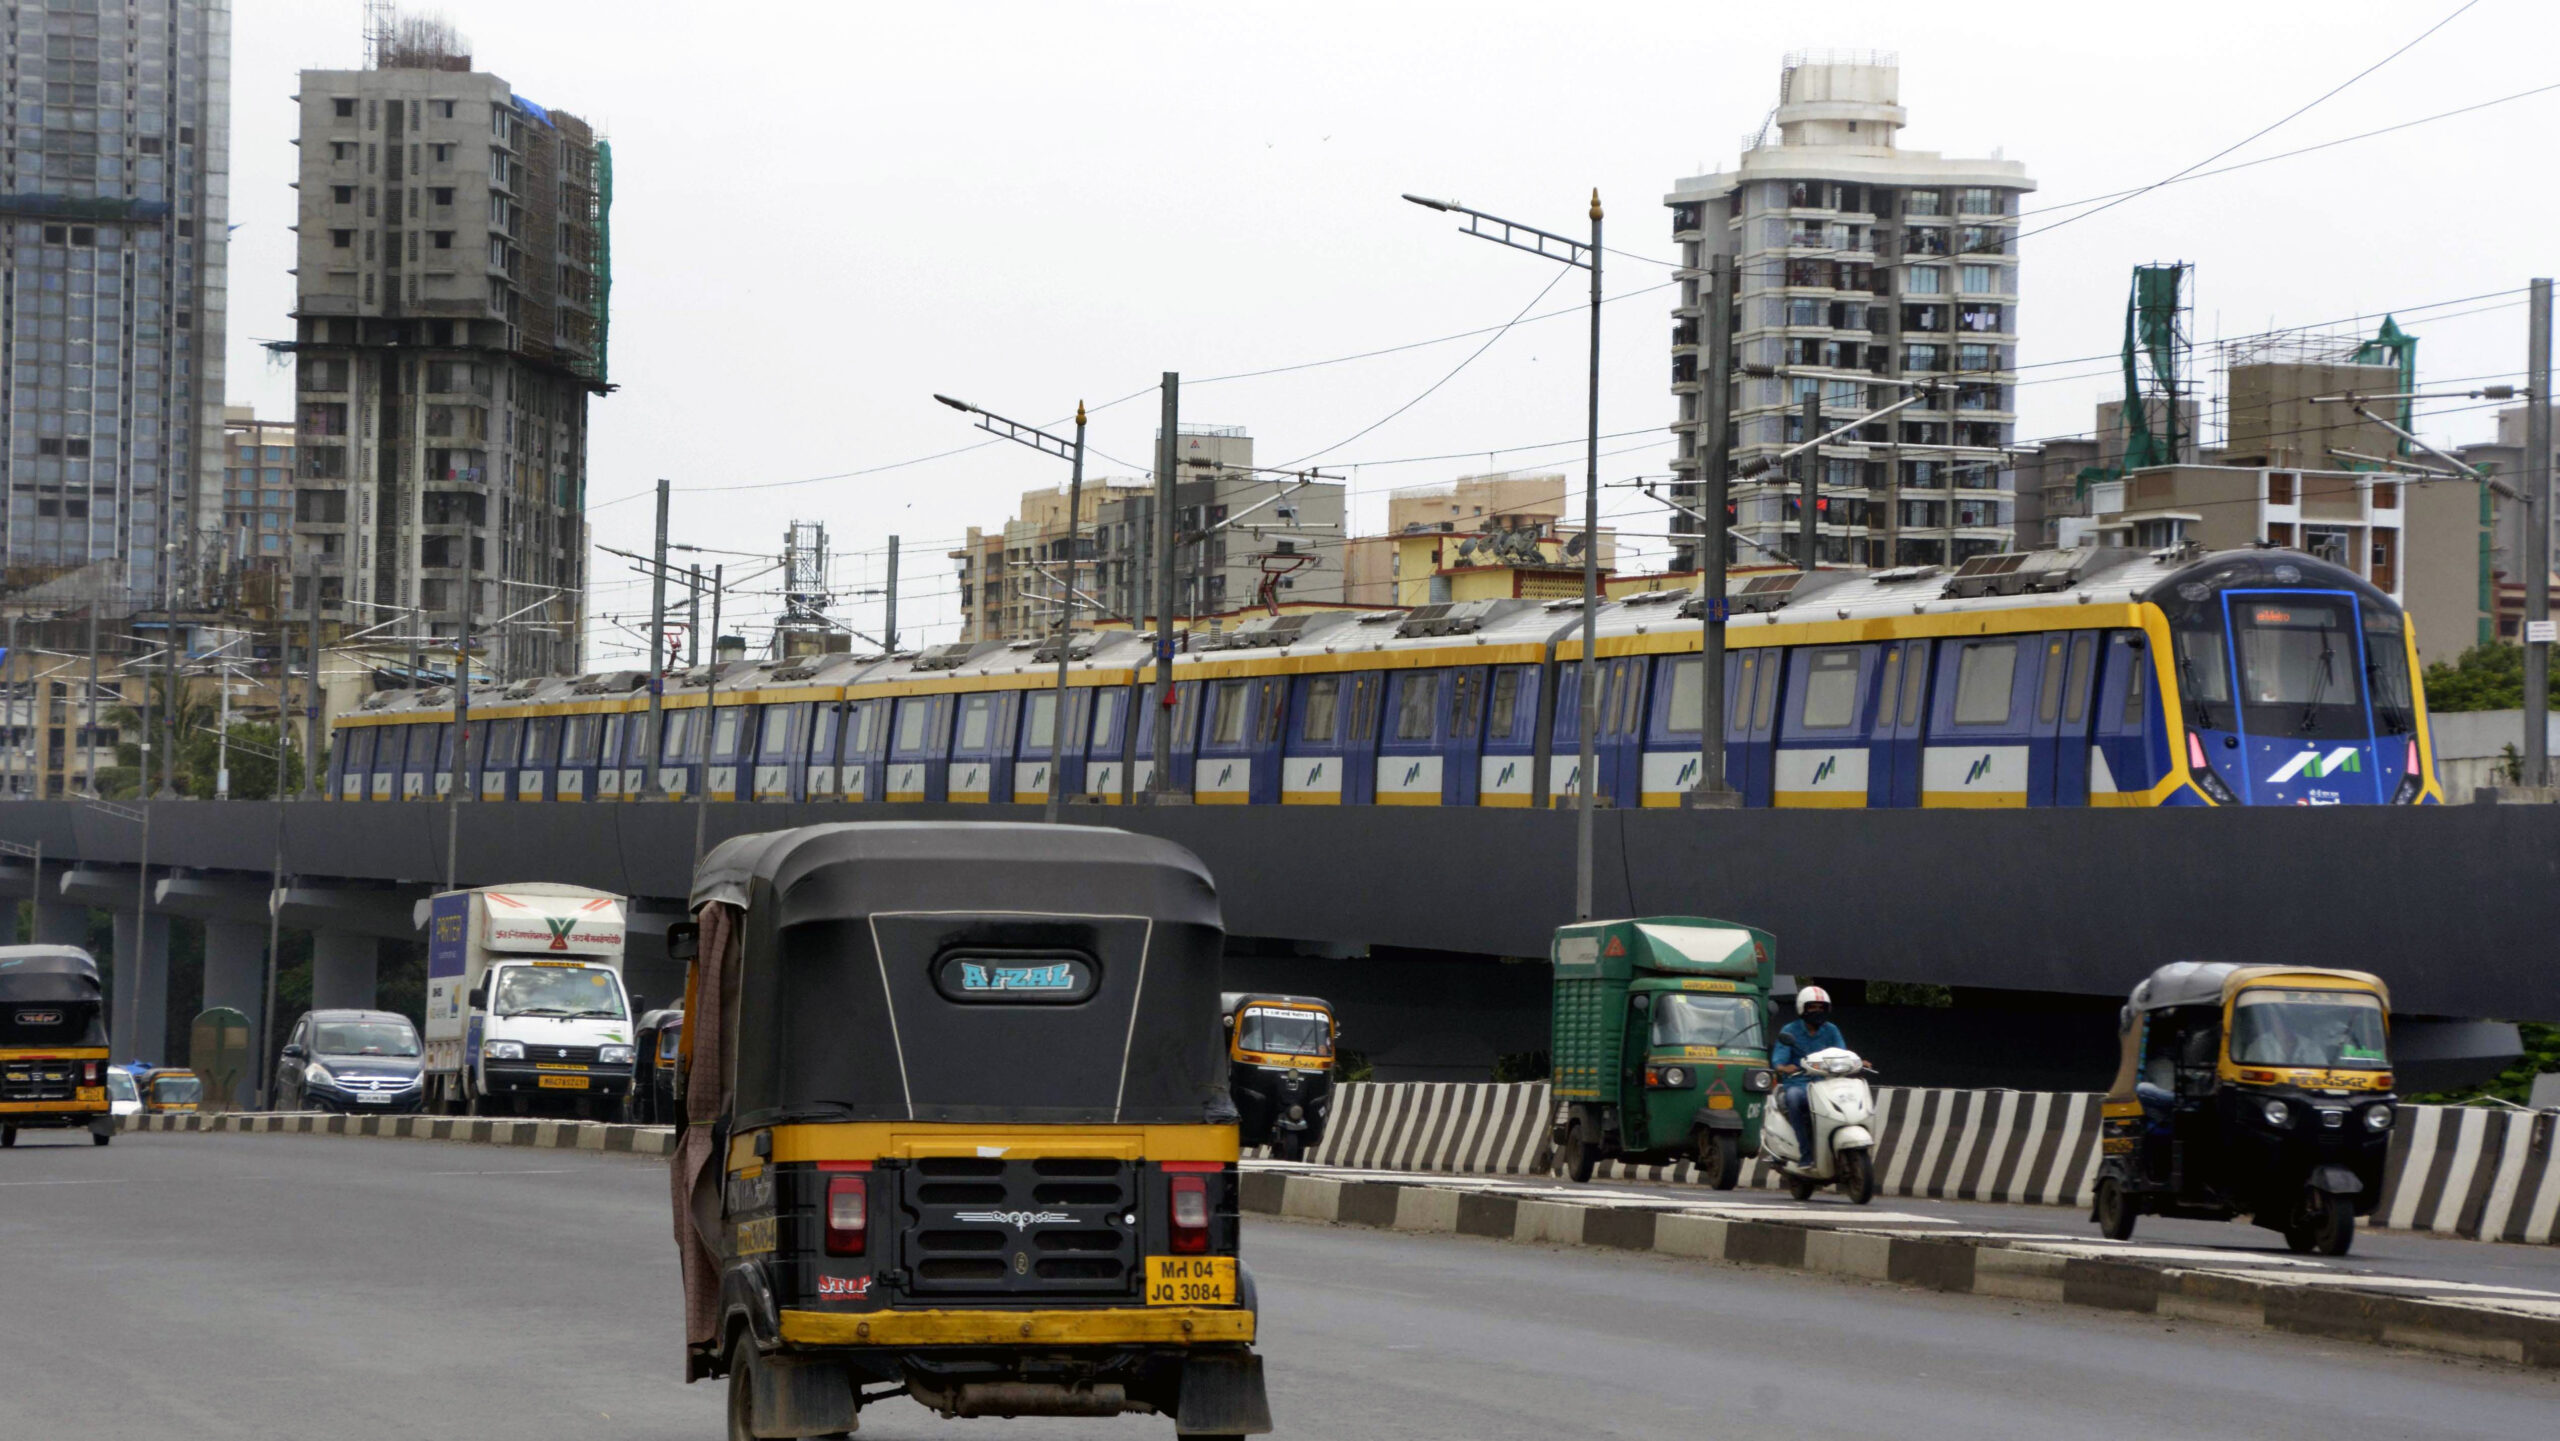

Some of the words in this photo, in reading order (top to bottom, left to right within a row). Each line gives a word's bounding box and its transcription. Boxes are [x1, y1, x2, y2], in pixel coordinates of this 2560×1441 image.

[1161, 1261, 1188, 1278] MH
[1194, 1261, 1213, 1278] 04
[819, 1274, 872, 1293] STOP
[1152, 1284, 1175, 1301] JQ
[1180, 1284, 1221, 1300] 3084
